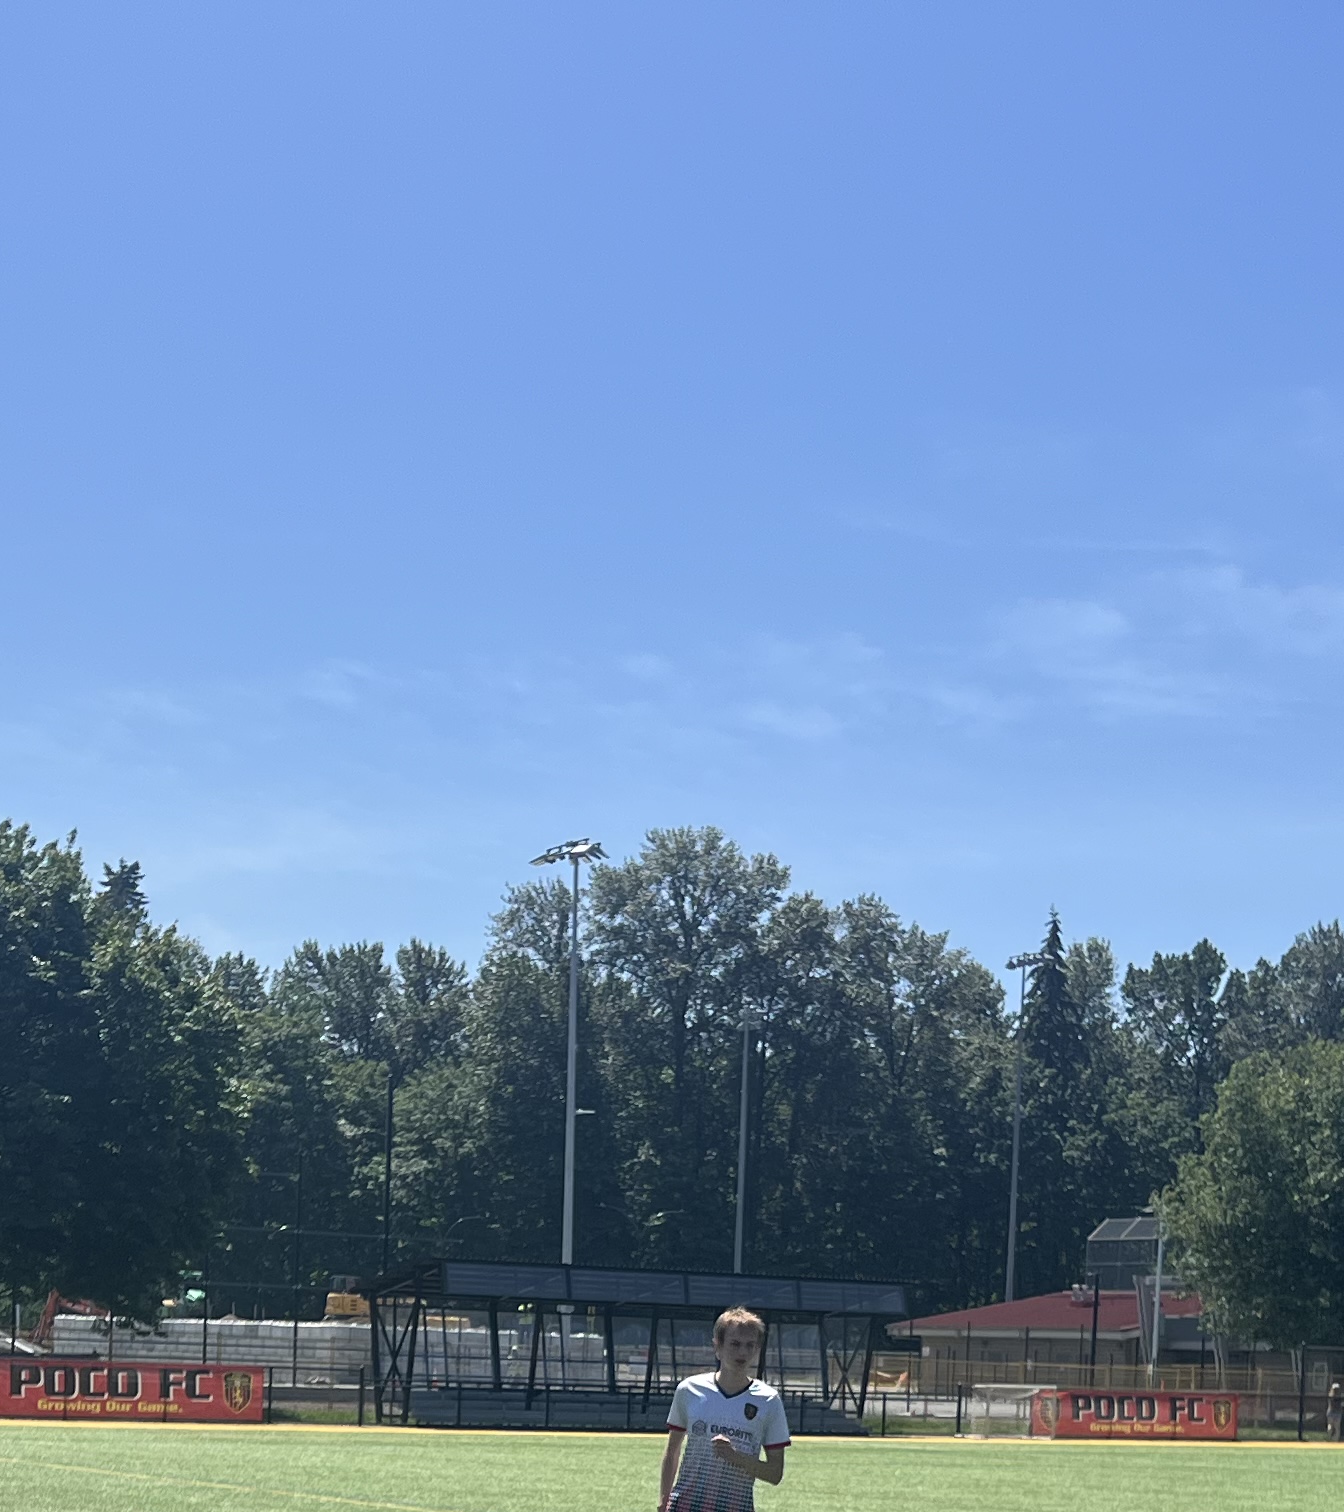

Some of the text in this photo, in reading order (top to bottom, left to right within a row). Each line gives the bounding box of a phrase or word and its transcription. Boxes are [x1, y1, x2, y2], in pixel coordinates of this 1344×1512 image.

[10, 1363, 214, 1403] POCO FC
[37, 1398, 101, 1414] Growing
[106, 1400, 133, 1412] Our
[1071, 1394, 1207, 1424] POCO FC
